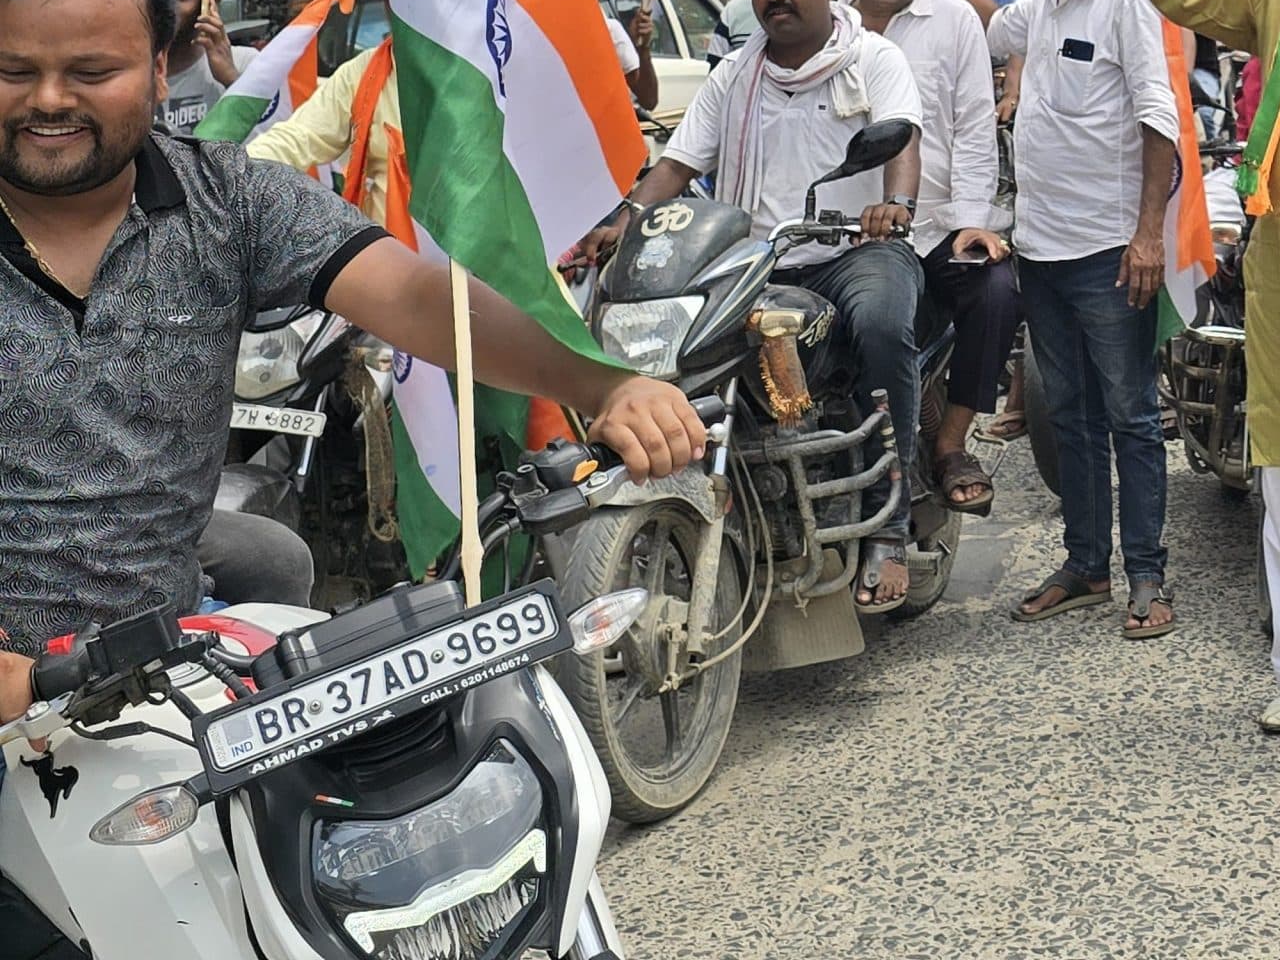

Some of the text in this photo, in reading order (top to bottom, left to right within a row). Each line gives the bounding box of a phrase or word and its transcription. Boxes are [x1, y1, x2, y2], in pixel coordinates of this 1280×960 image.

[447, 602, 546, 665] 9699
[420, 686, 453, 705] CALL
[460, 652, 530, 688] 6201148674
[231, 741, 254, 758] IND
[249, 738, 324, 774] AHMAD
[328, 720, 369, 742] TVS
